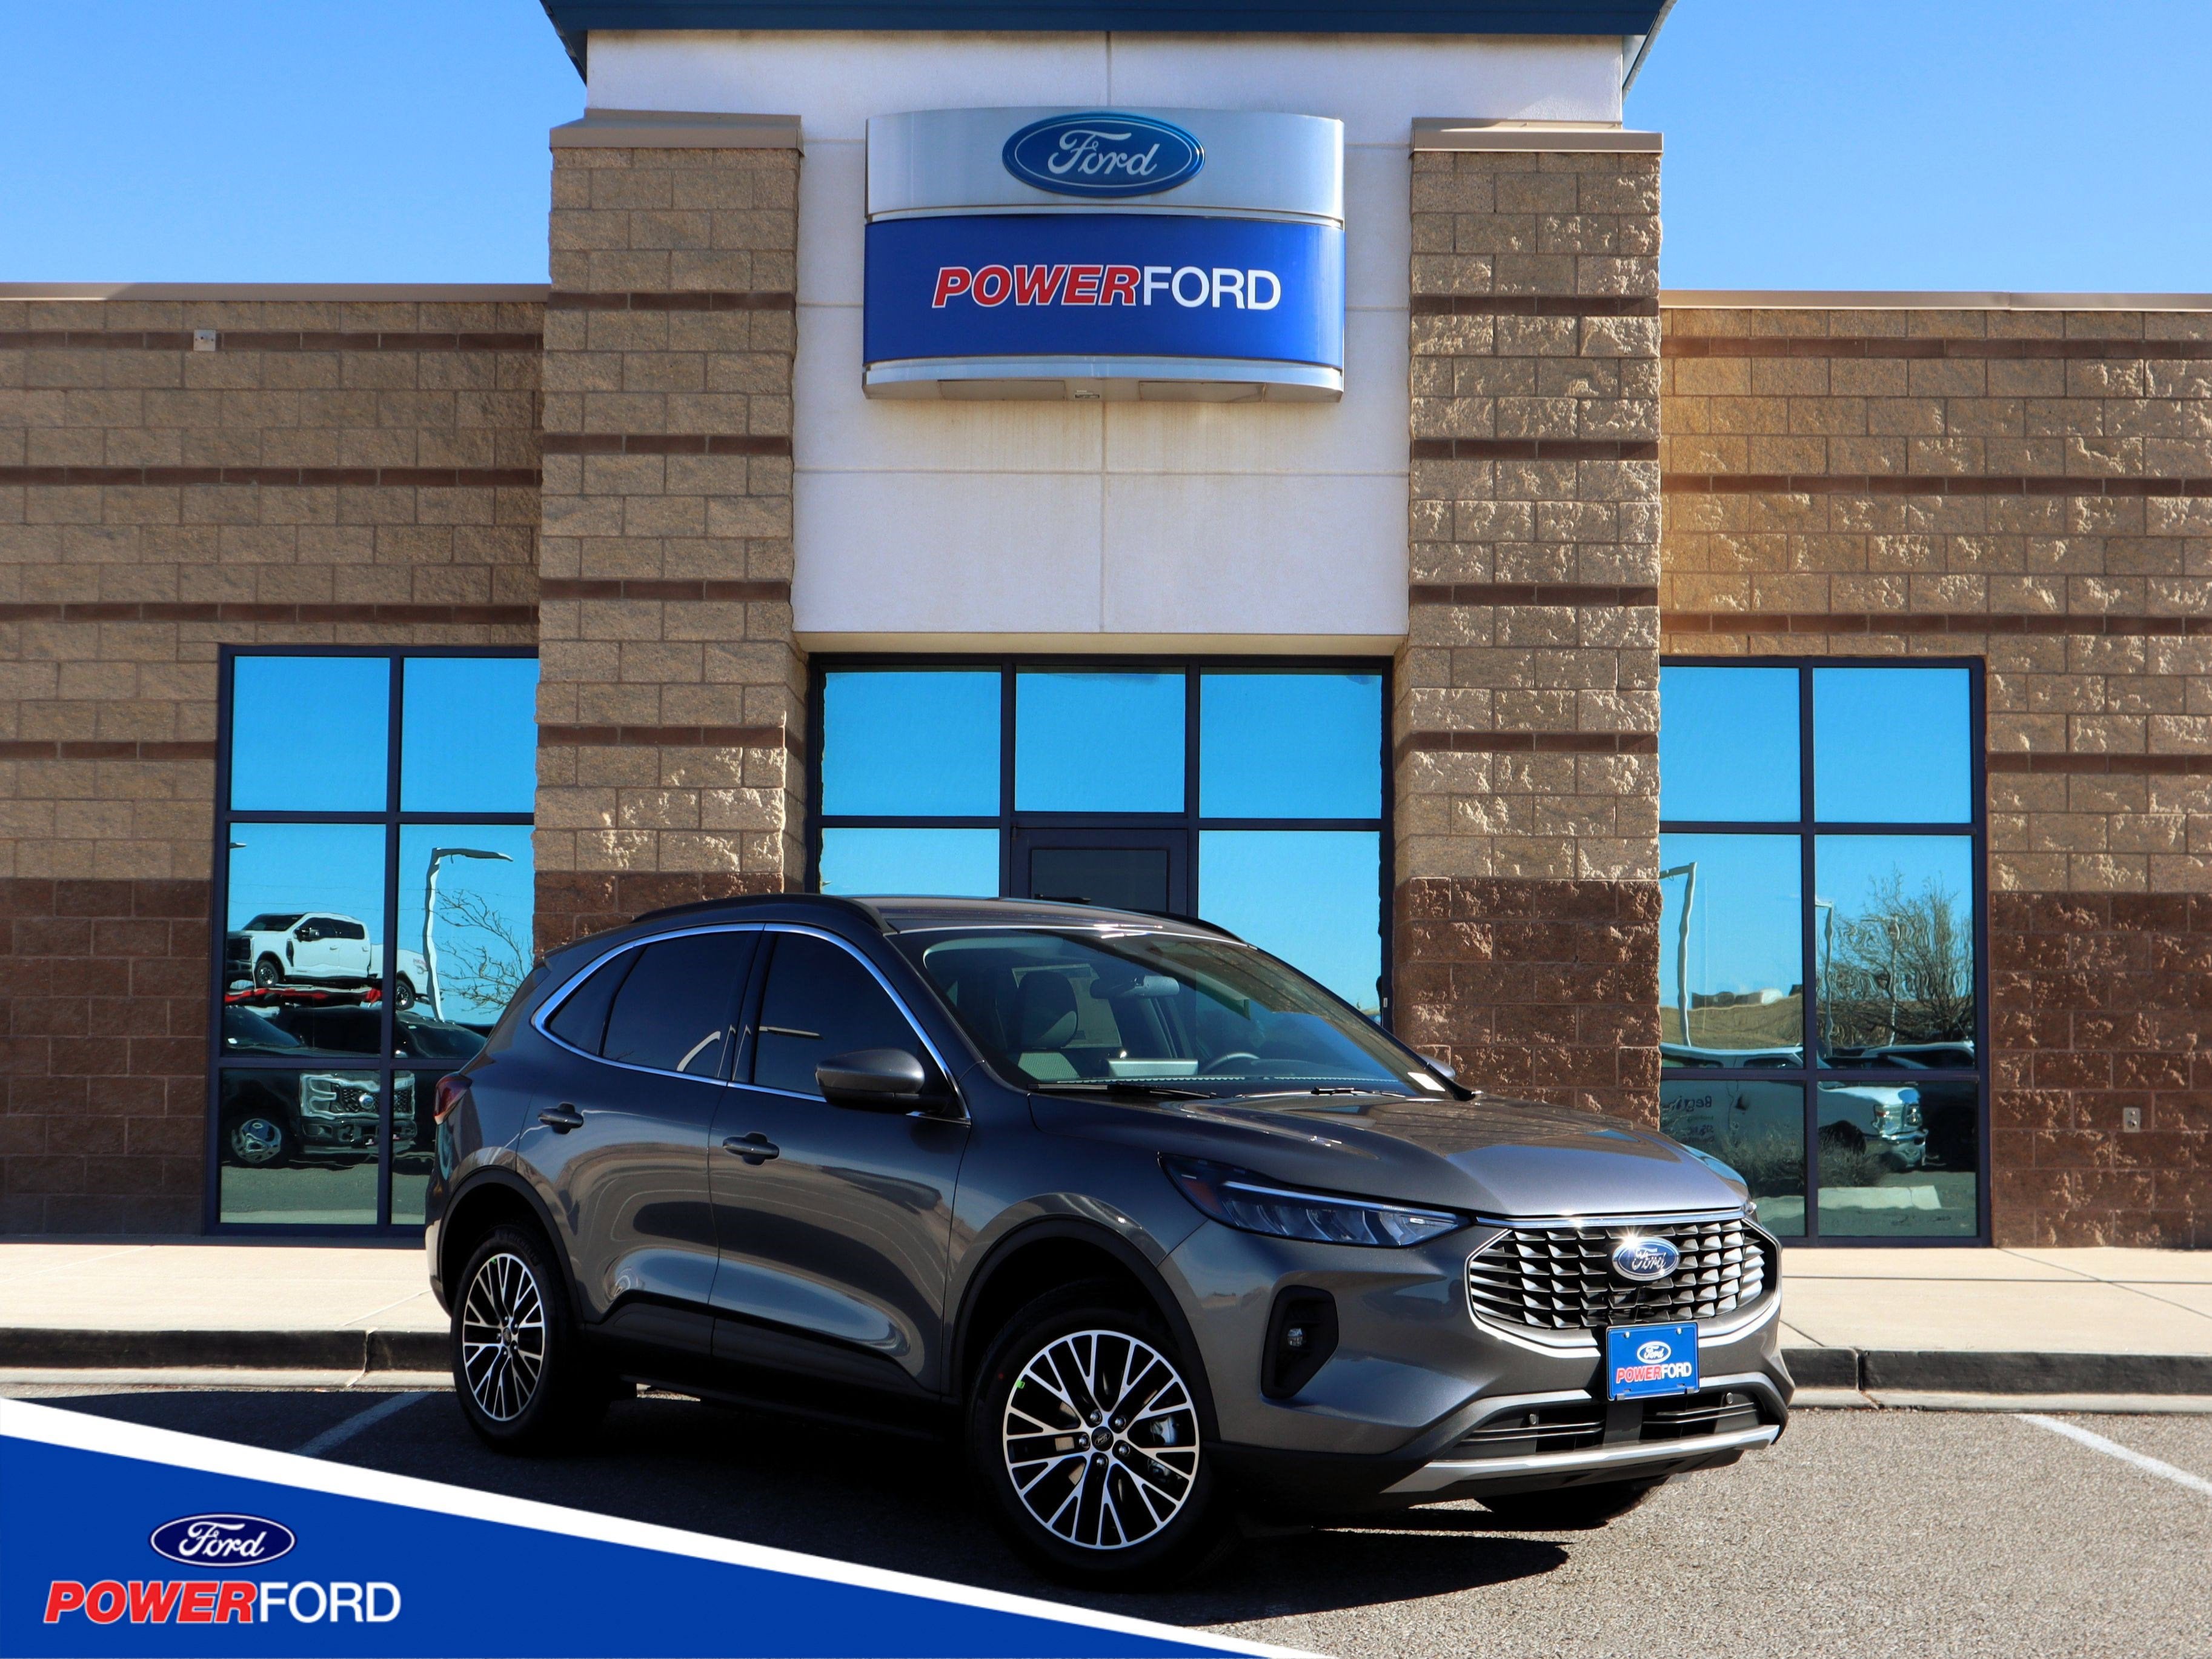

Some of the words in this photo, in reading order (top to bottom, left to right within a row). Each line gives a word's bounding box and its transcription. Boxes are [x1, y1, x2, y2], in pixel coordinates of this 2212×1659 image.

[1048, 129, 1160, 176] Ford
[931, 264, 1282, 310] POWERFORD
[1631, 1248, 1667, 1271] Ford
[1644, 1345, 1665, 1359] Ford
[1616, 1361, 1692, 1384] POWERFORD
